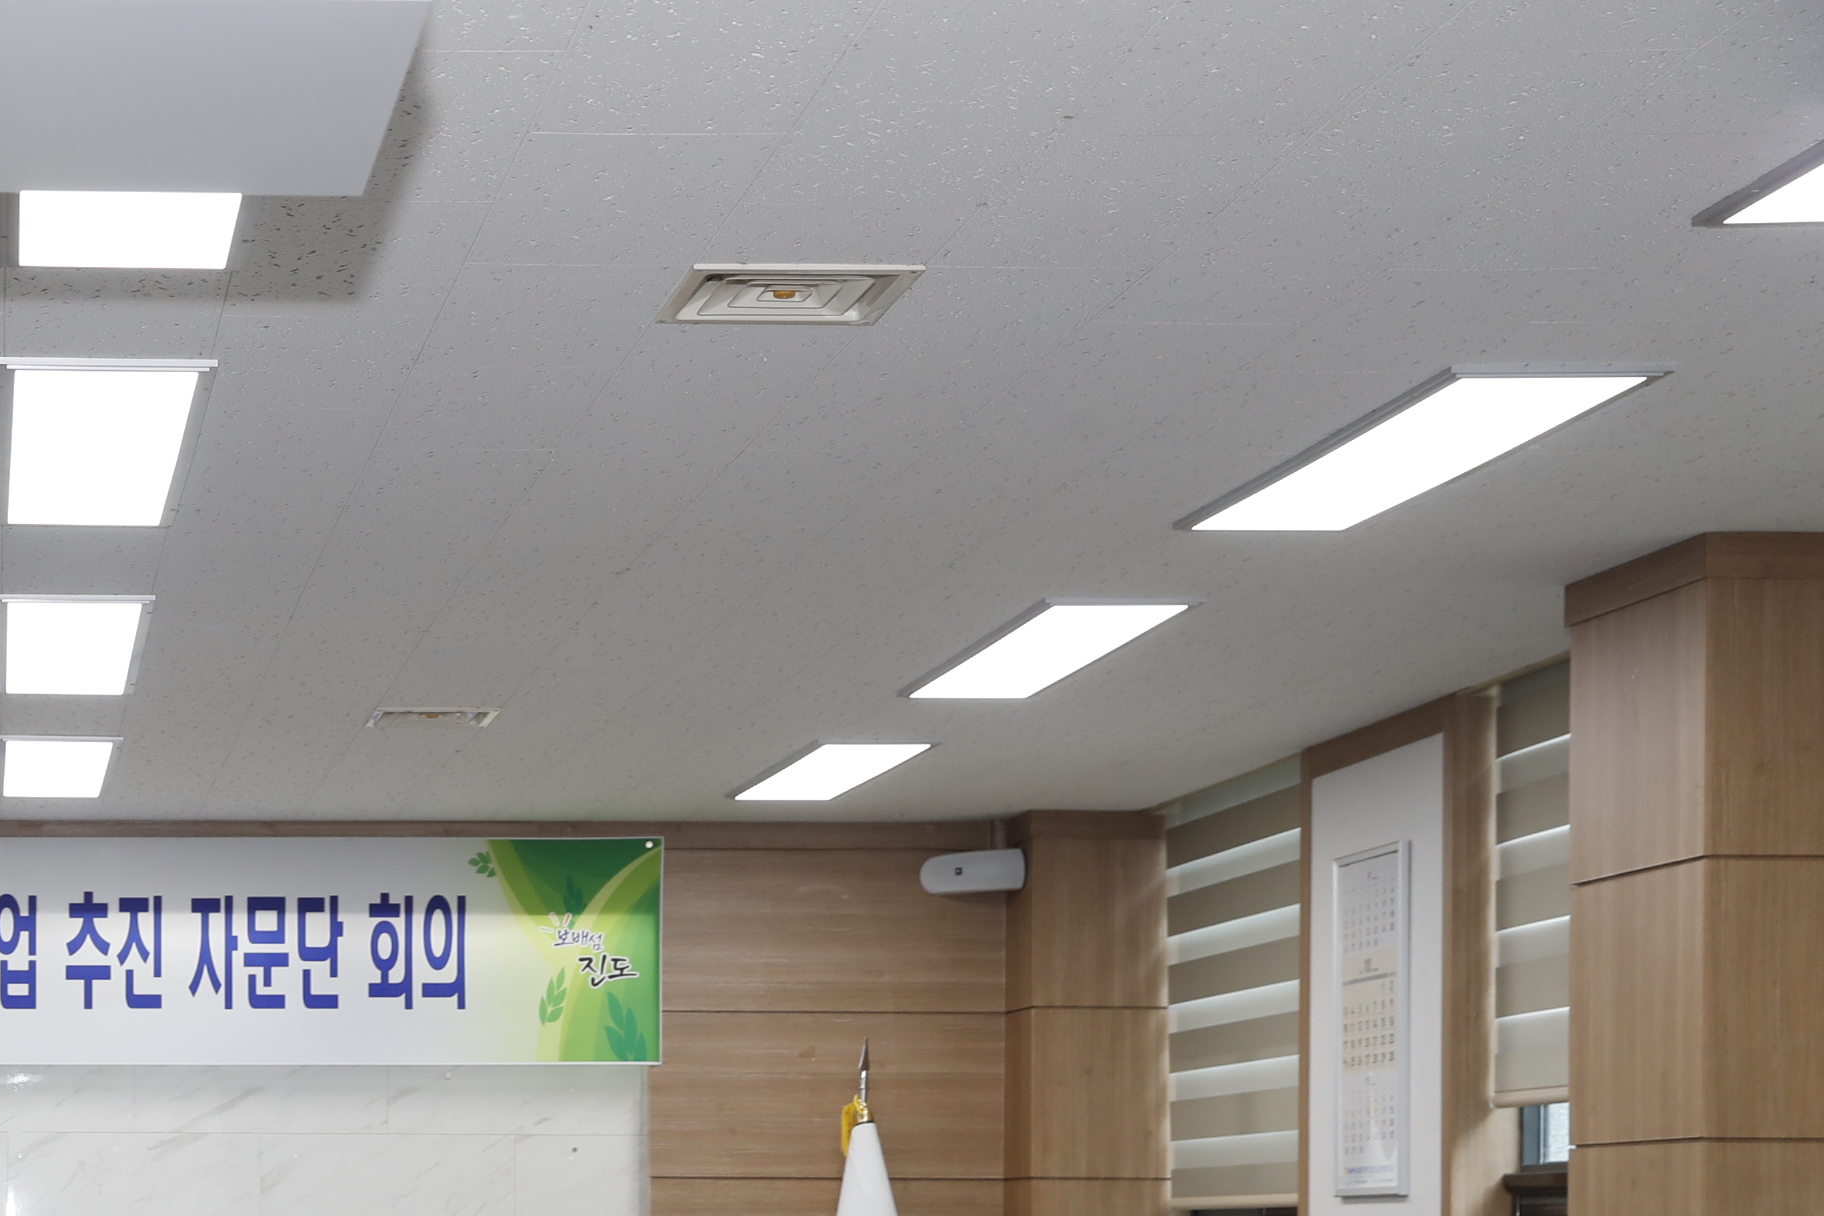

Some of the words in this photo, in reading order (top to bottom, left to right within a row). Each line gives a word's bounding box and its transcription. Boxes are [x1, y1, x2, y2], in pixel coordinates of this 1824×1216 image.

[65, 891, 162, 1010] 추진
[188, 894, 344, 1010] 자문단
[368, 892, 466, 1010] 회의
[554, 929, 603, 951] 보배섬
[578, 954, 637, 987] 진도
